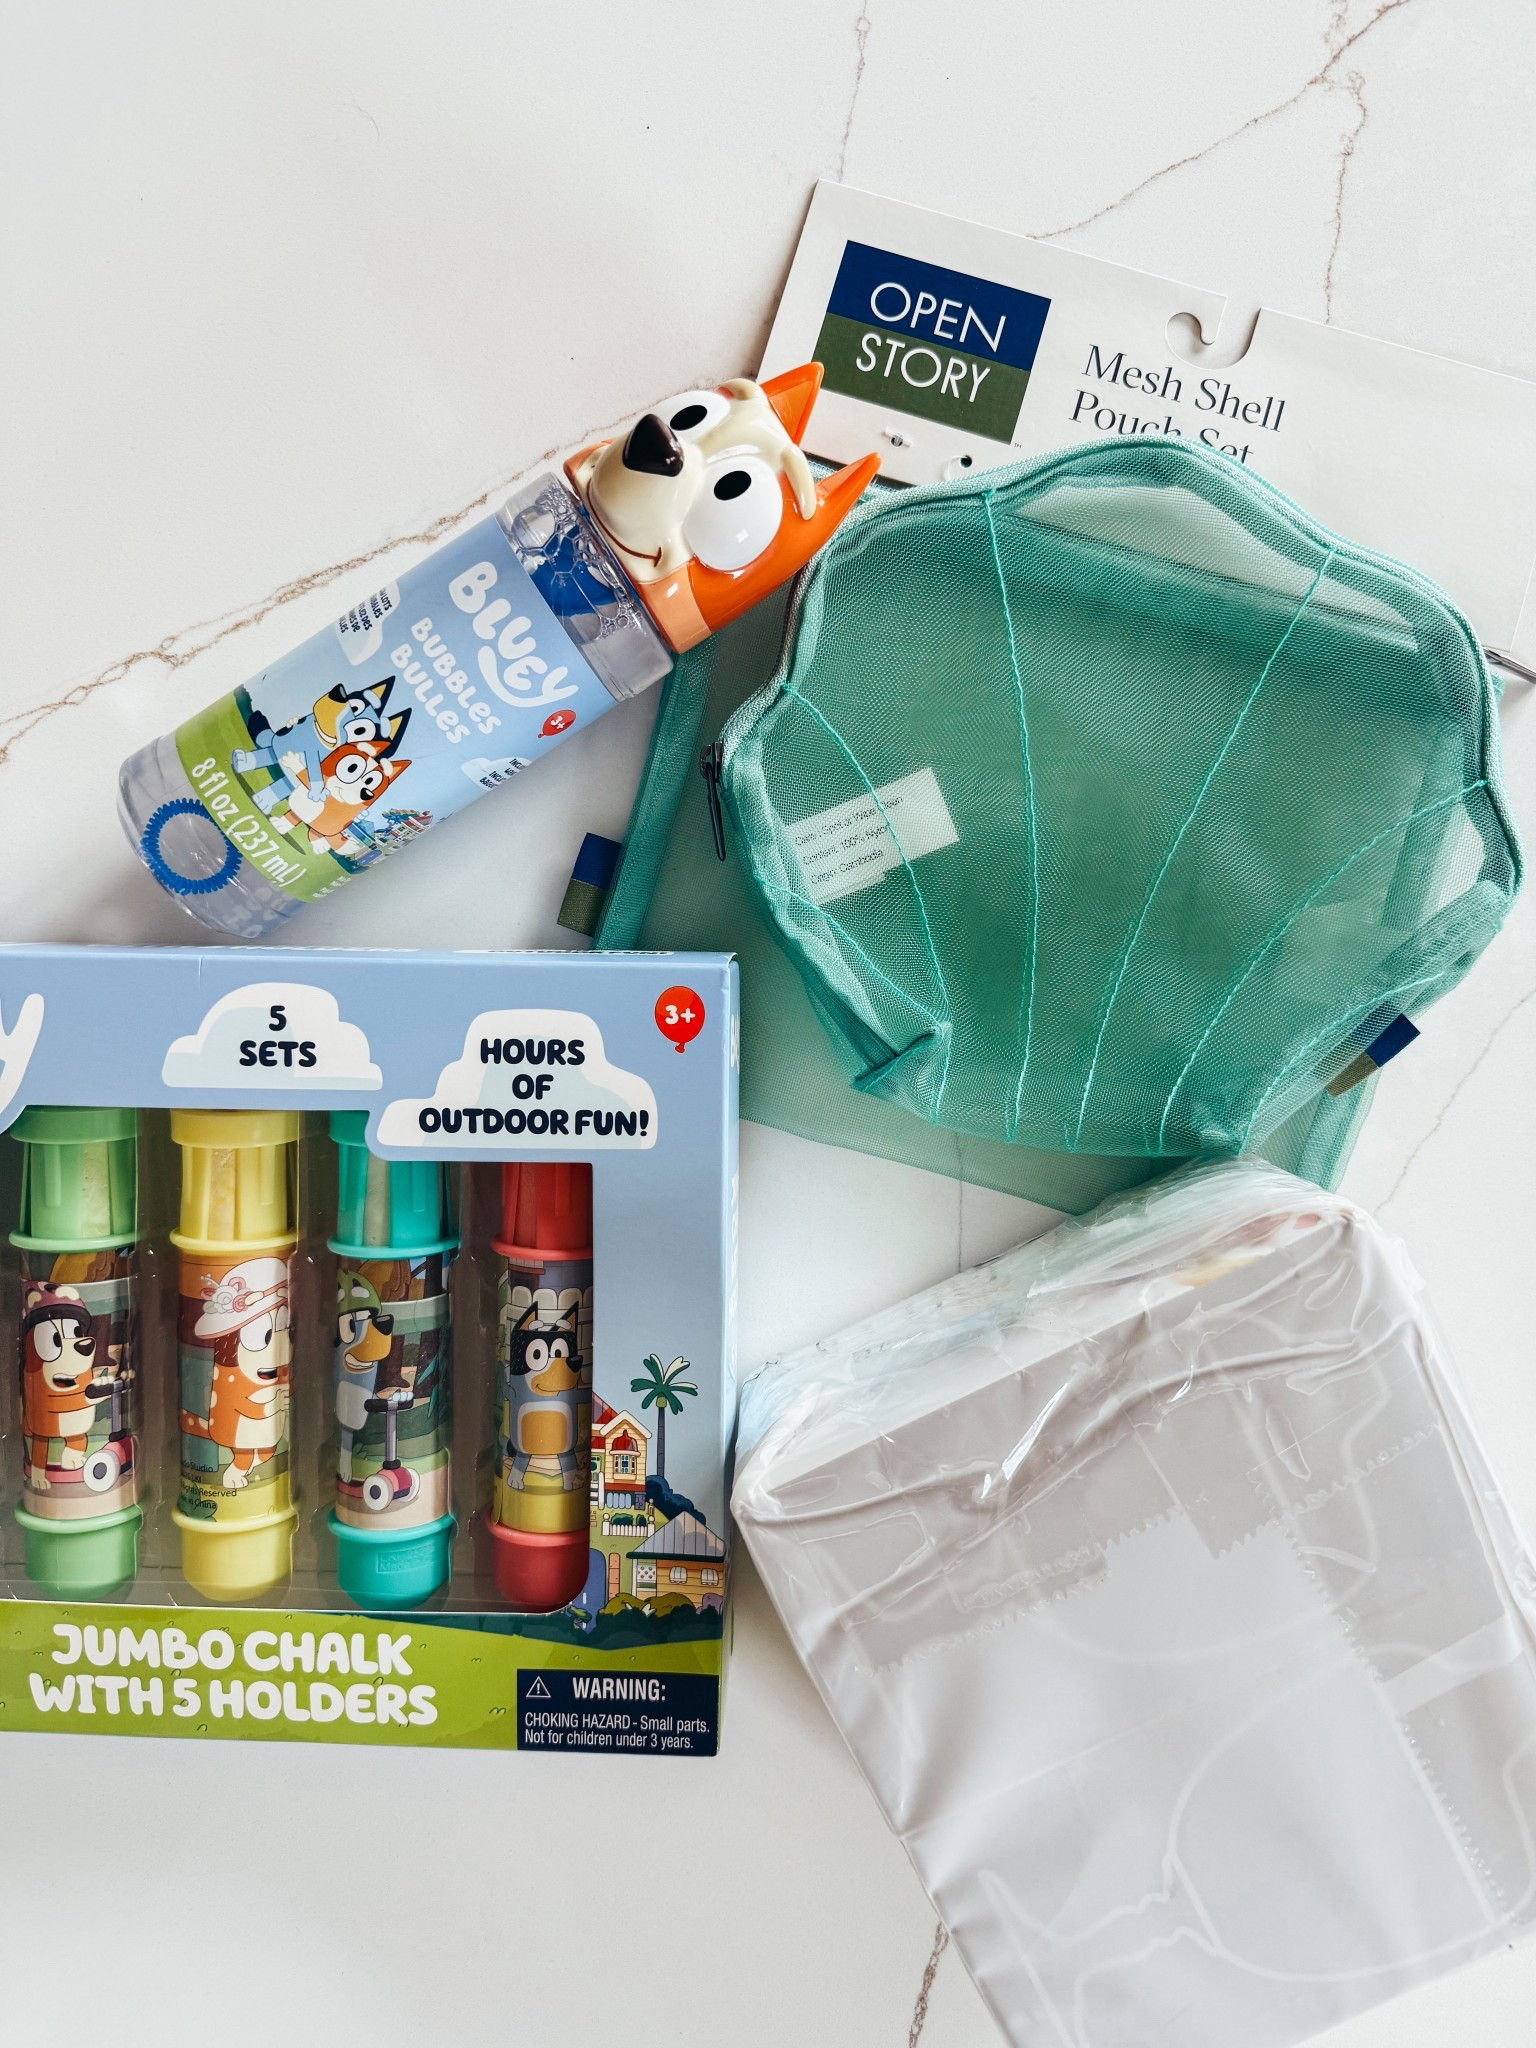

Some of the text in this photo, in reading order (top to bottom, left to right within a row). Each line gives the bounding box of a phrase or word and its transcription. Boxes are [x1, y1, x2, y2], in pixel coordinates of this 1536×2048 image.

[870, 282, 1006, 353] OPEN
[855, 332, 991, 403] STORY
[1081, 343, 1285, 433] Mesh Shell
[448, 561, 580, 708] BLUEY
[550, 715, 566, 729] 3+
[191, 757, 217, 778] 8
[268, 1005, 287, 1031] 5
[665, 1004, 696, 1025] 3+
[239, 1039, 317, 1067] SETS
[480, 1038, 586, 1066] HOURS
[511, 1073, 554, 1100] OF
[418, 1107, 650, 1137] OUTDOOR FUN!
[199, 1487, 238, 1497] Reserved
[52, 1623, 413, 1675] JUMBO CHALK
[29, 1672, 438, 1726] WITH 5 HOLDERS
[572, 1676, 667, 1702] WARNING:
[524, 1711, 579, 1729] CHOKING
[582, 1713, 631, 1730] HAZARD
[640, 1716, 673, 1732] Small
[676, 1719, 711, 1734] parts.
[524, 1729, 694, 1750] Not for children under 3 years.
